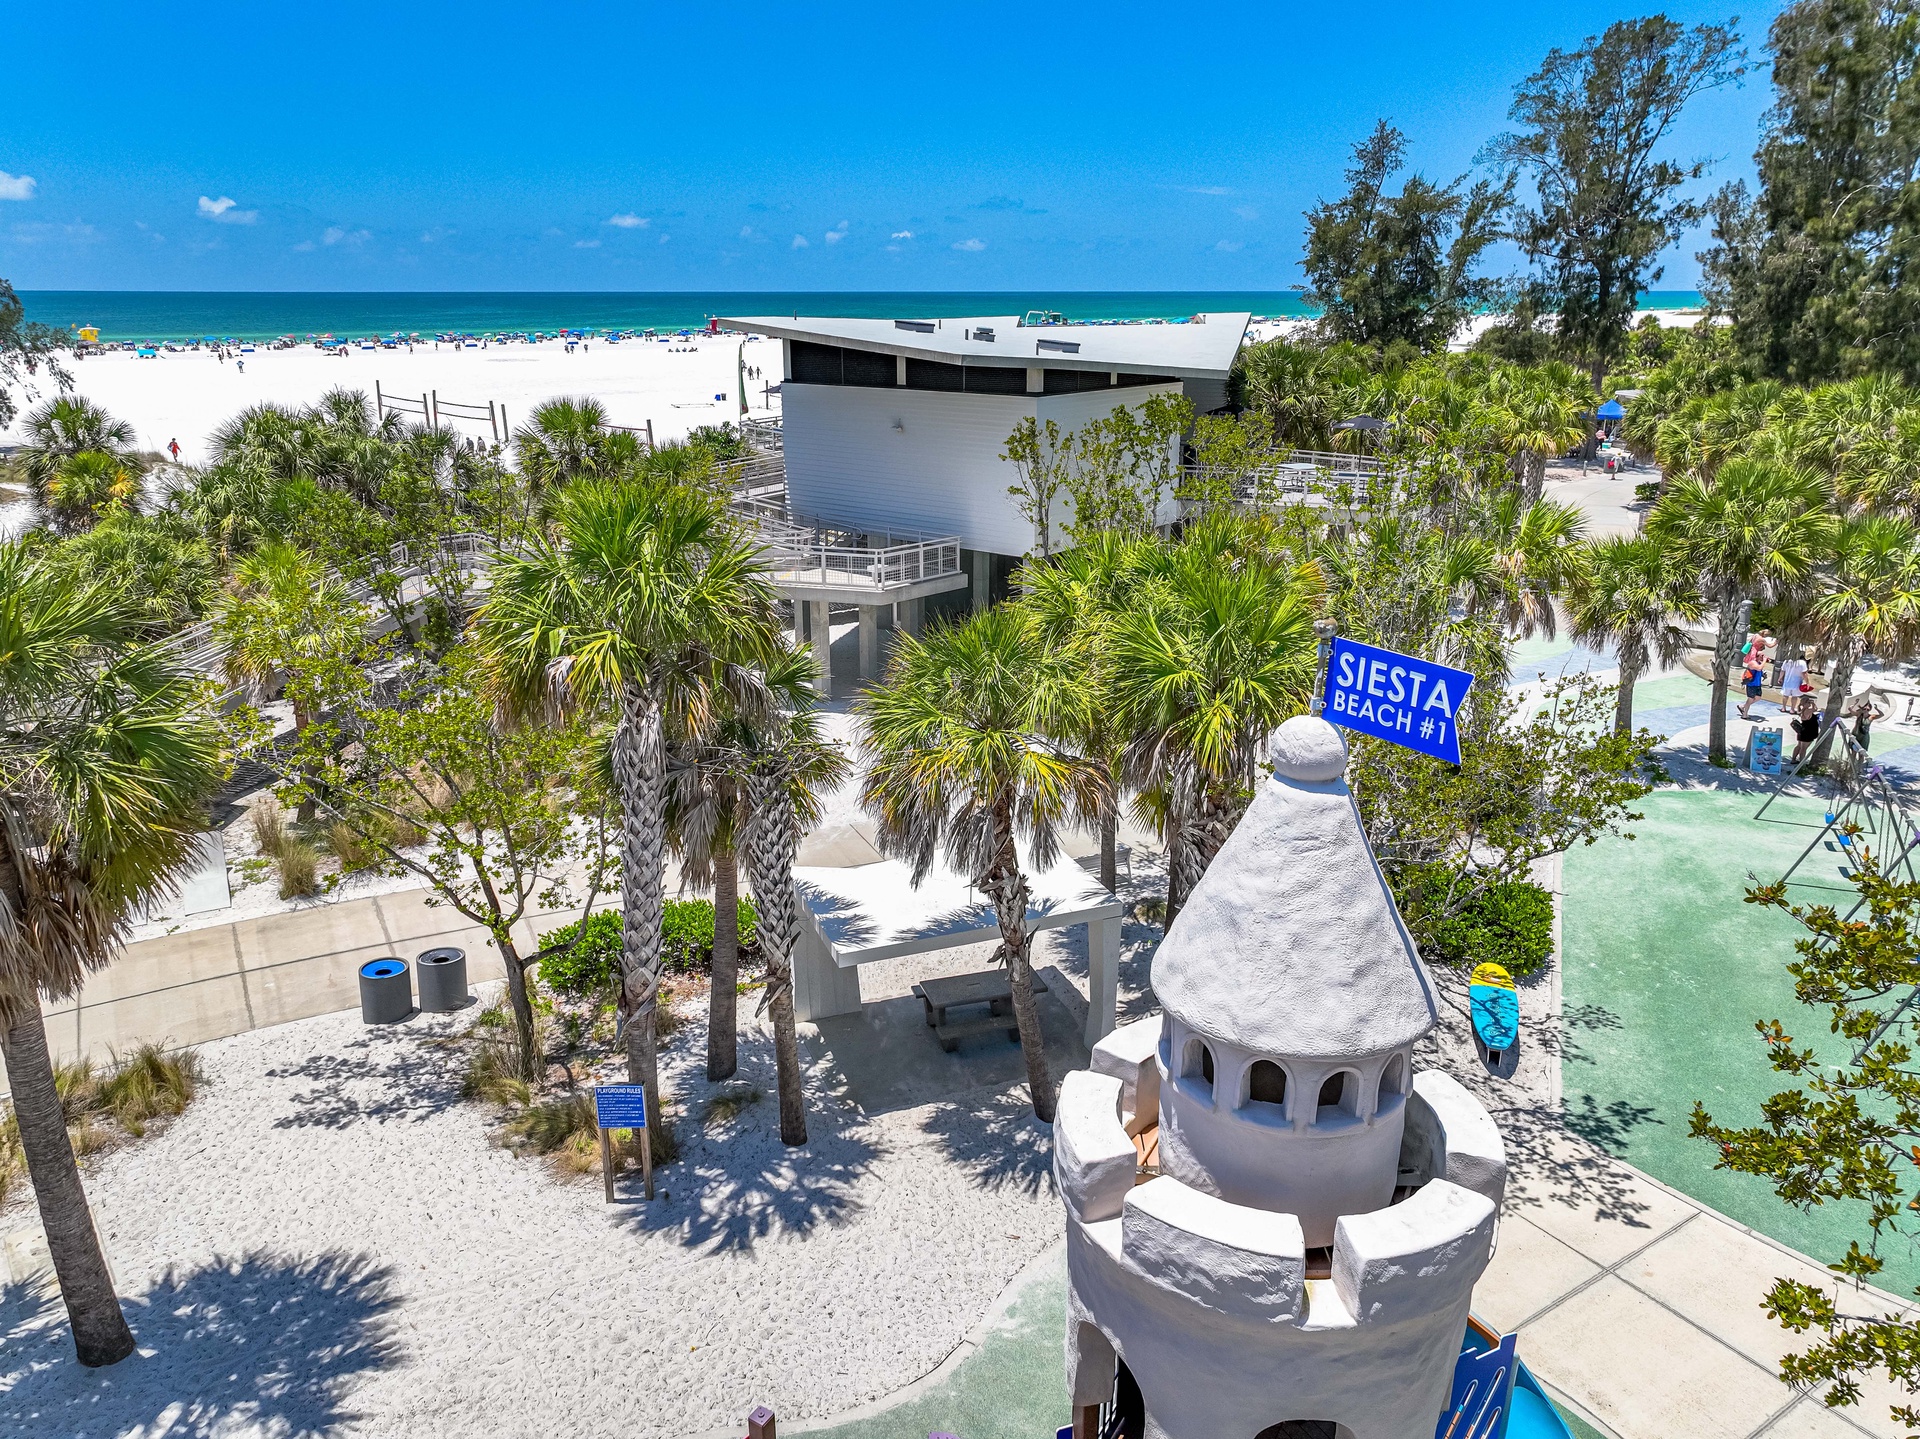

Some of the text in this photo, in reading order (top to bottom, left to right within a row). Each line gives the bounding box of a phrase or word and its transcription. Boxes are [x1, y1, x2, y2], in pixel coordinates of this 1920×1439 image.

[1336, 652, 1452, 719] SIESTA
[1333, 689, 1447, 745] BEACH #1
